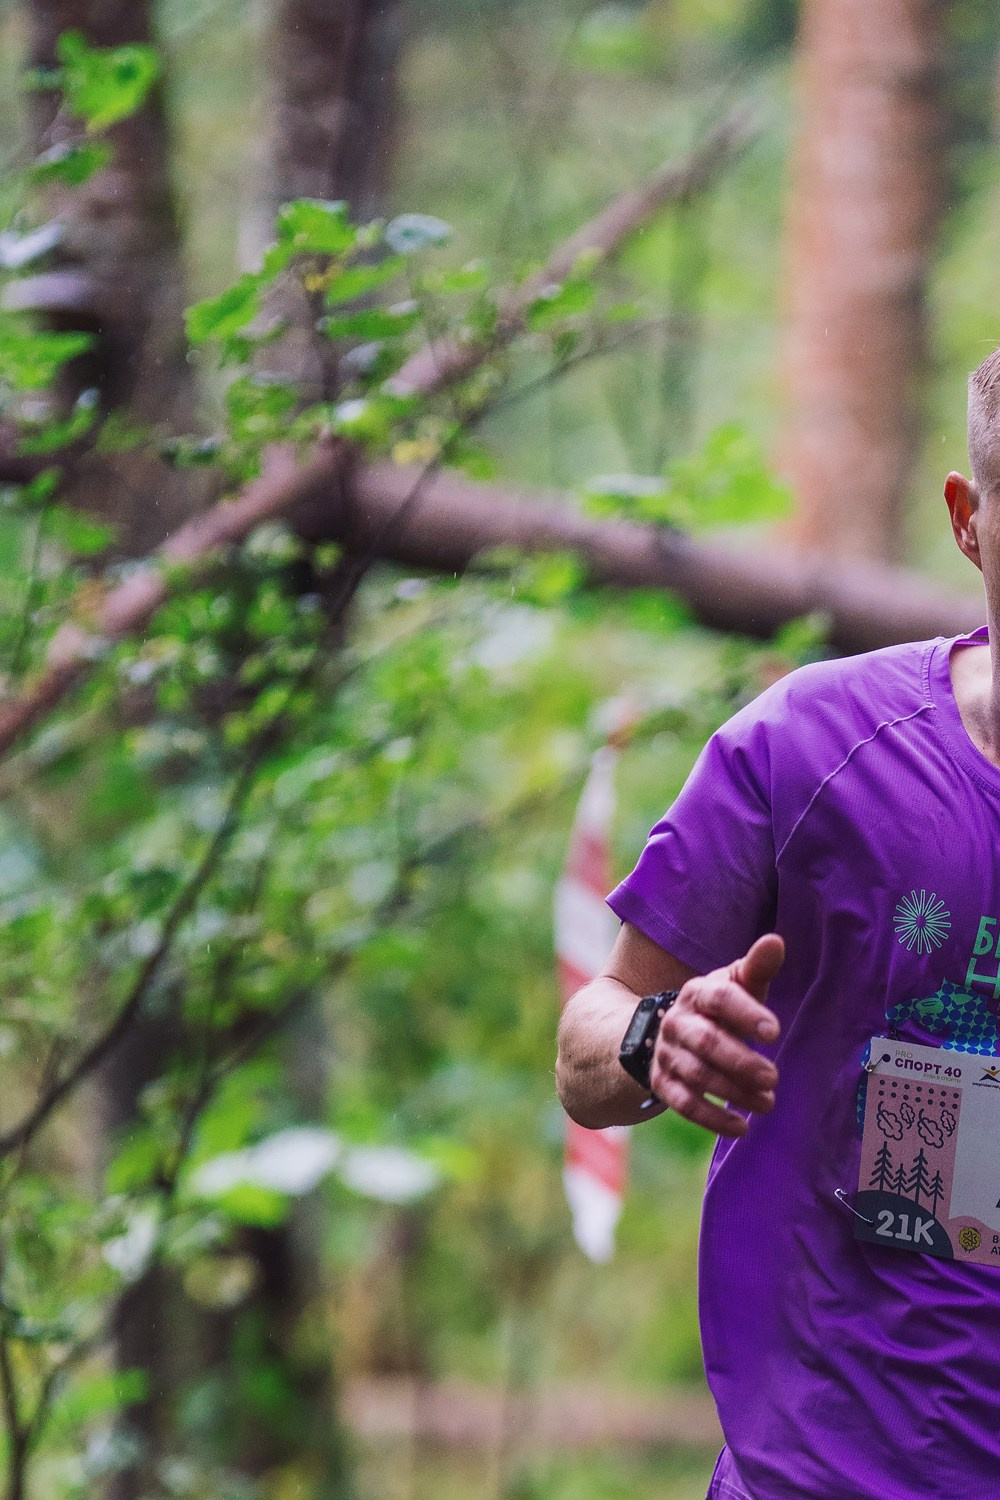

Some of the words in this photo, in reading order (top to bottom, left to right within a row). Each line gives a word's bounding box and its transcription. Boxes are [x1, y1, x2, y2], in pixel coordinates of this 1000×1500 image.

[895, 1050, 913, 1059] PRO
[895, 1058, 942, 1075] СПОРТ
[944, 1066, 962, 1078] 40
